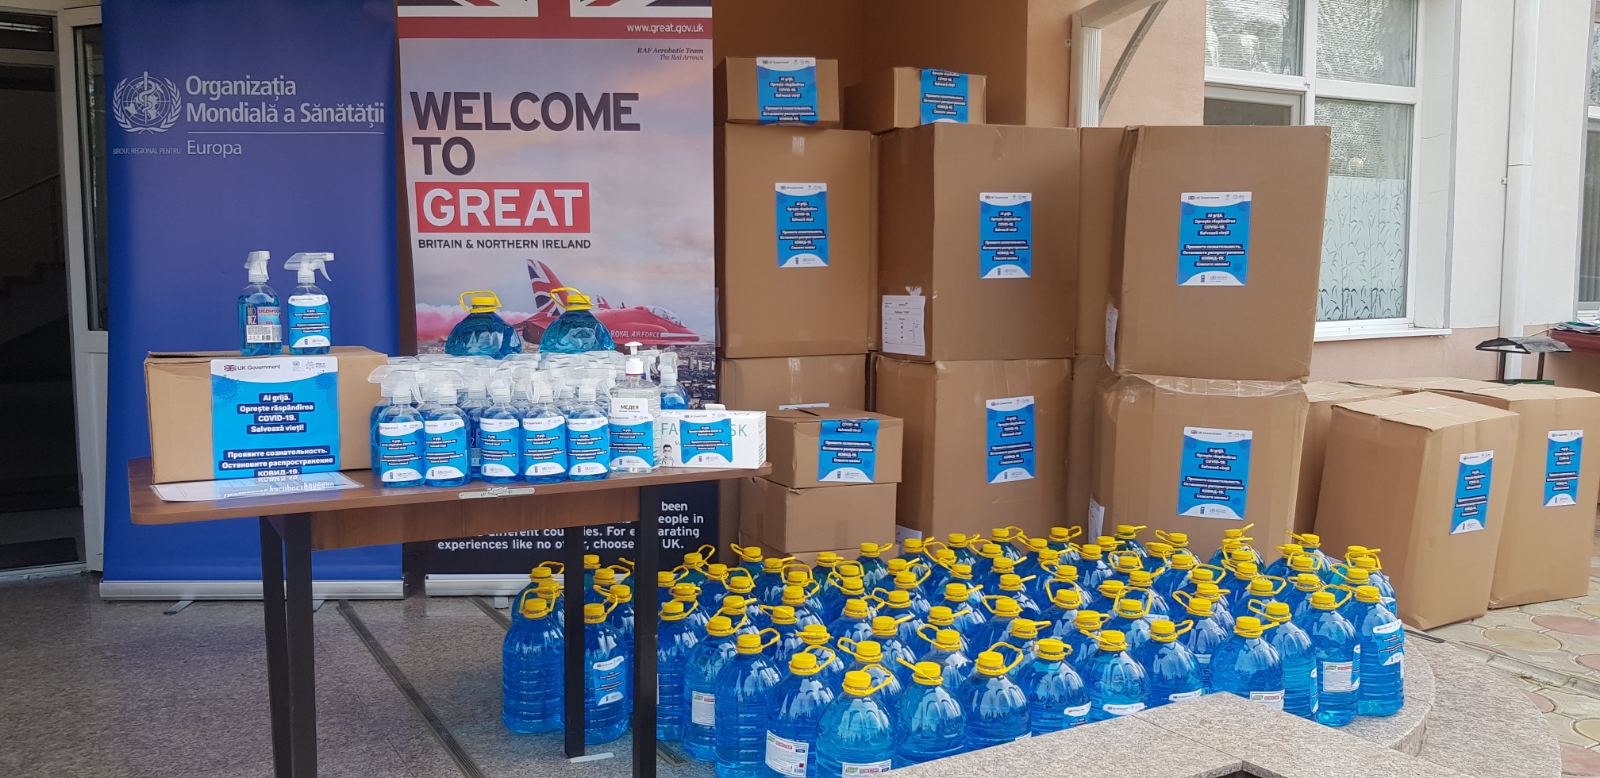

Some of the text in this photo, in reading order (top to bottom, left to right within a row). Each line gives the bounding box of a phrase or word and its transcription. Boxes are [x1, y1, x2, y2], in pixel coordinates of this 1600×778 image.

[626, 24, 704, 34] www.great.gov.uk
[186, 76, 296, 101] Organizația
[186, 102, 384, 128] Mondială a Sănătății
[410, 92, 640, 131] WELCOME
[187, 140, 242, 158] Europa
[412, 136, 476, 176] TO
[423, 188, 582, 226] GREAT
[418, 240, 591, 249] BRITAIN & NORTHERN IRELAND
[272, 394, 290, 402] grijă.
[285, 424, 304, 432] vieți!
[228, 448, 328, 459] Проявите сознательность.
[268, 458, 333, 468] распространение
[662, 501, 688, 511] been
[658, 514, 704, 525] eople in
[606, 526, 626, 536] For
[438, 540, 508, 551] experiences
[513, 540, 533, 549] like
[537, 541, 551, 549] no
[594, 539, 634, 549] choose
[662, 539, 684, 548] UK.
